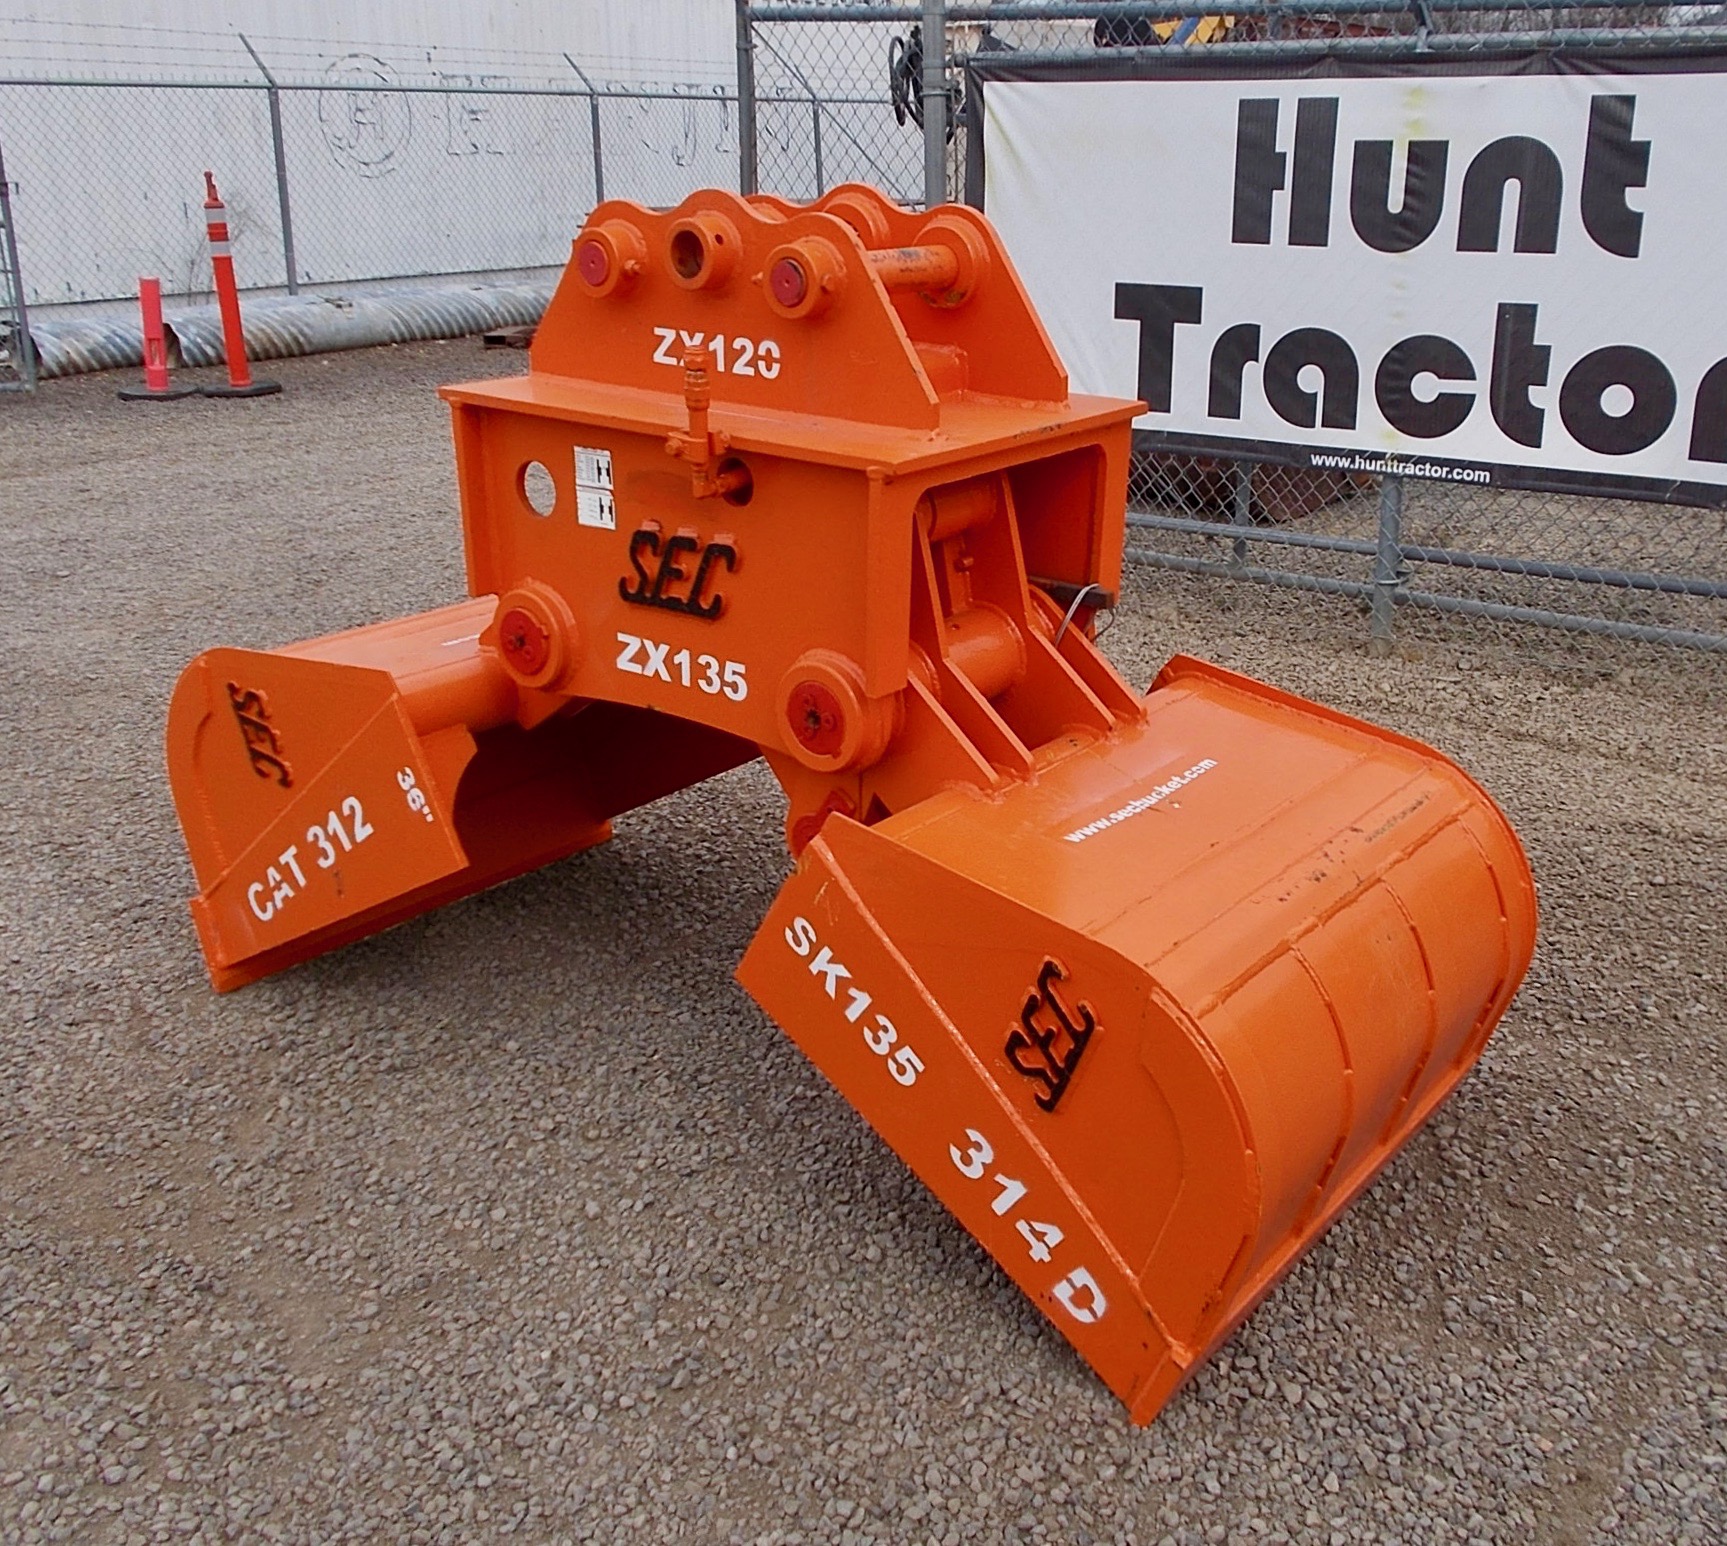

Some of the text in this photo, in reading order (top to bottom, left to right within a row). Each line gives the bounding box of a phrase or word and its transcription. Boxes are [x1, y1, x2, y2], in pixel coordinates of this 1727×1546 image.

[1231, 94, 1652, 258] Hunt
[653, 326, 780, 380] ZX120
[1310, 453, 1491, 484] www.hunttractor.com
[618, 528, 737, 620] SEC
[616, 632, 748, 702] ZX135
[247, 796, 375, 922] CAT 312
[785, 916, 926, 1087] SK135
